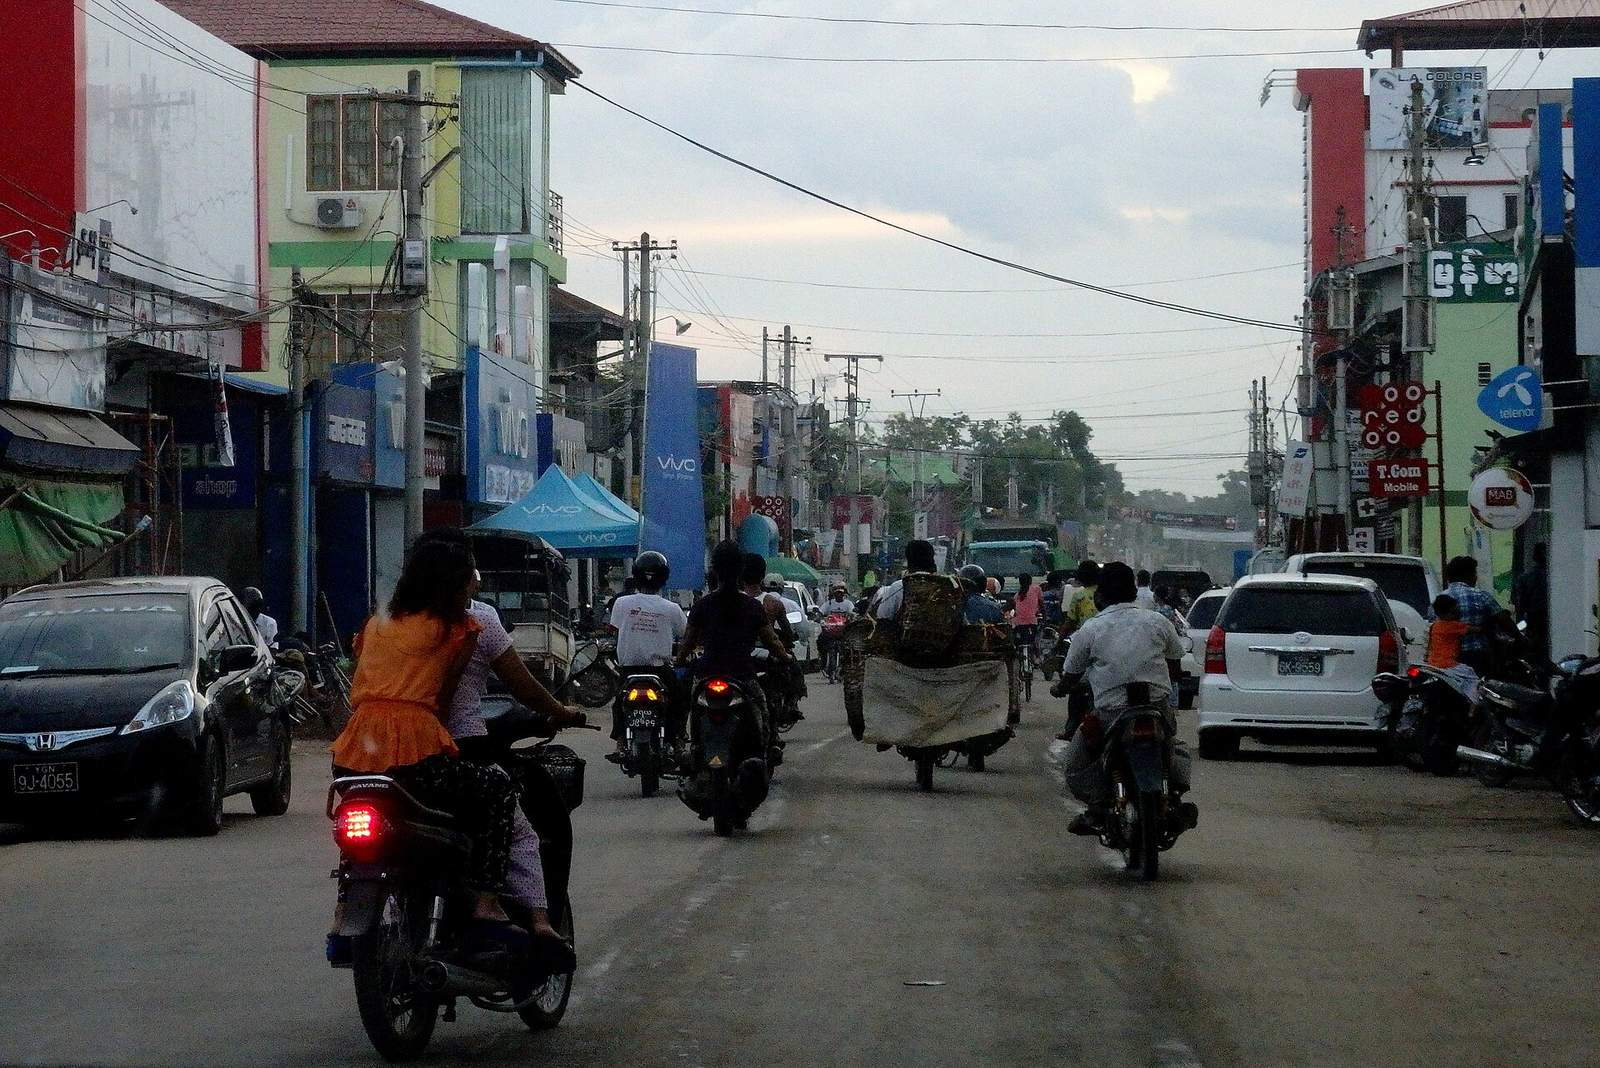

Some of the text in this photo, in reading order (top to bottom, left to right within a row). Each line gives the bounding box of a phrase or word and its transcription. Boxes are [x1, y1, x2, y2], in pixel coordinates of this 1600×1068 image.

[1426, 72, 1482, 81] COLORS
[1499, 408, 1535, 419] telenor
[1384, 483, 1419, 492] Mobile
[1488, 489, 1513, 500] MAB
[18, 773, 74, 791] 9J-4055
